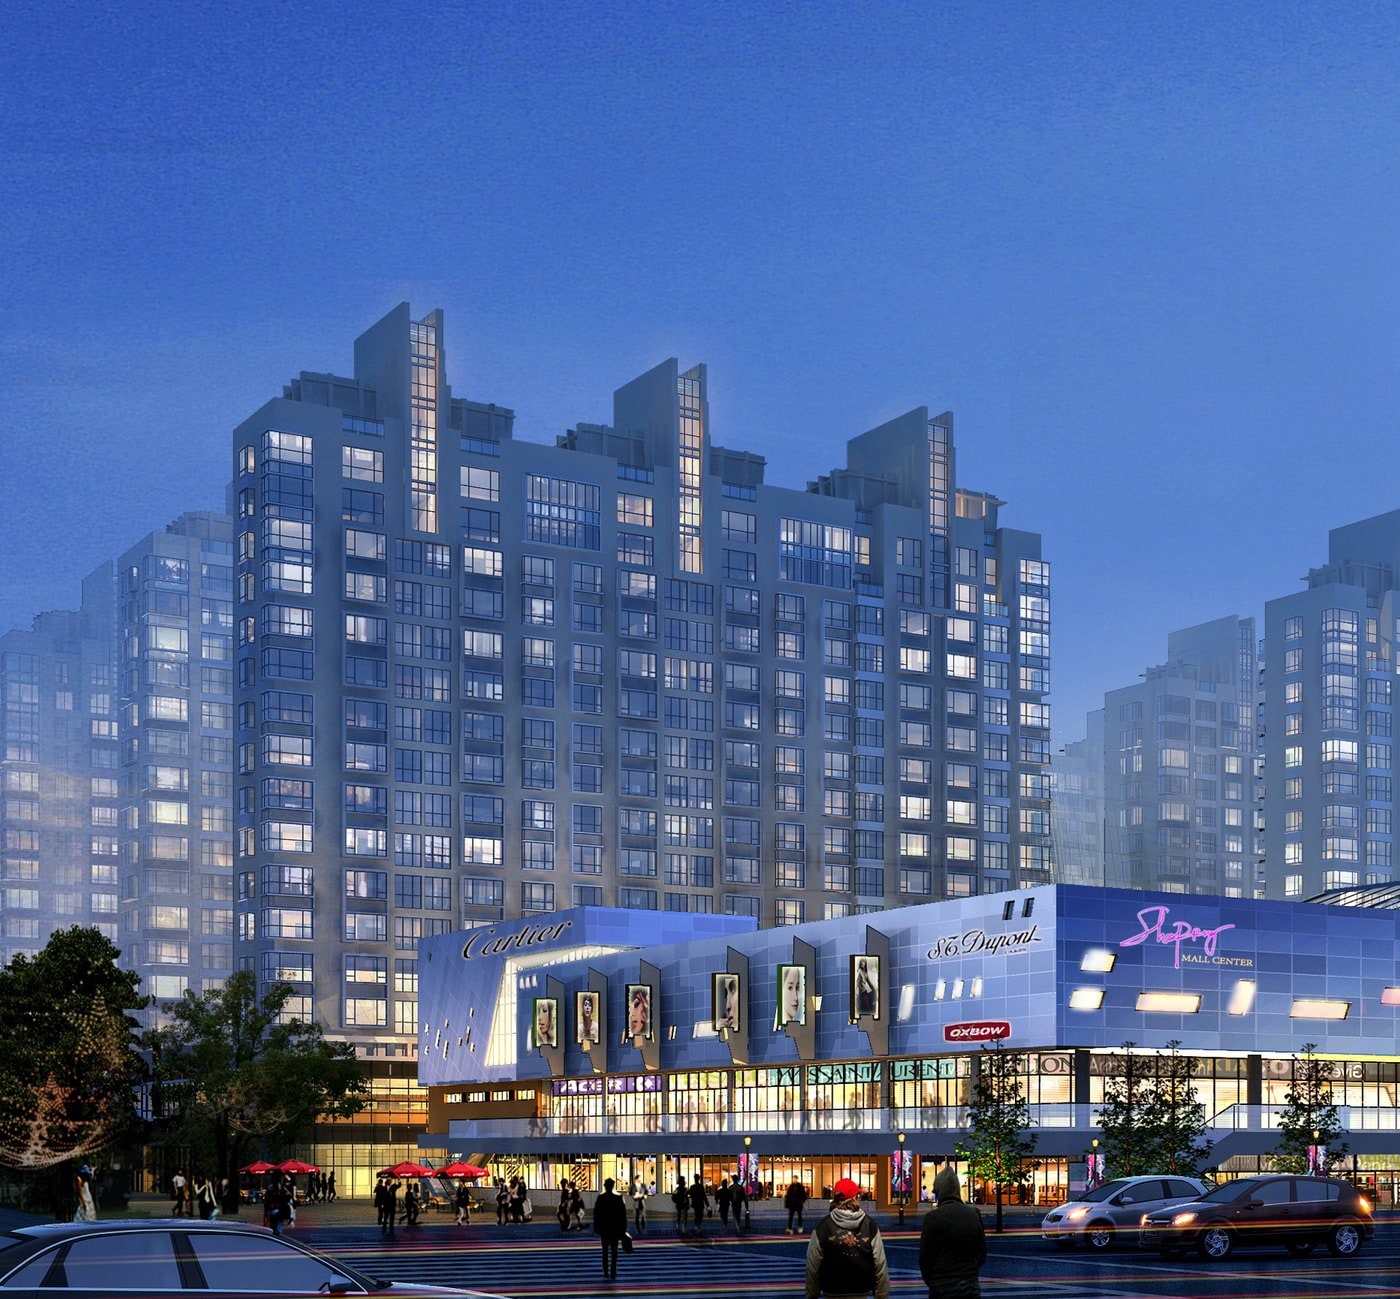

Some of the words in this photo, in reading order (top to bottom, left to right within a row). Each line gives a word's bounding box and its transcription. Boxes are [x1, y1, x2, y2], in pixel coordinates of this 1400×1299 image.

[463, 921, 572, 959] Cartier
[1181, 954, 1211, 964] MALL
[1212, 956, 1254, 967] CENTER
[949, 1026, 1005, 1038] OXBOW
